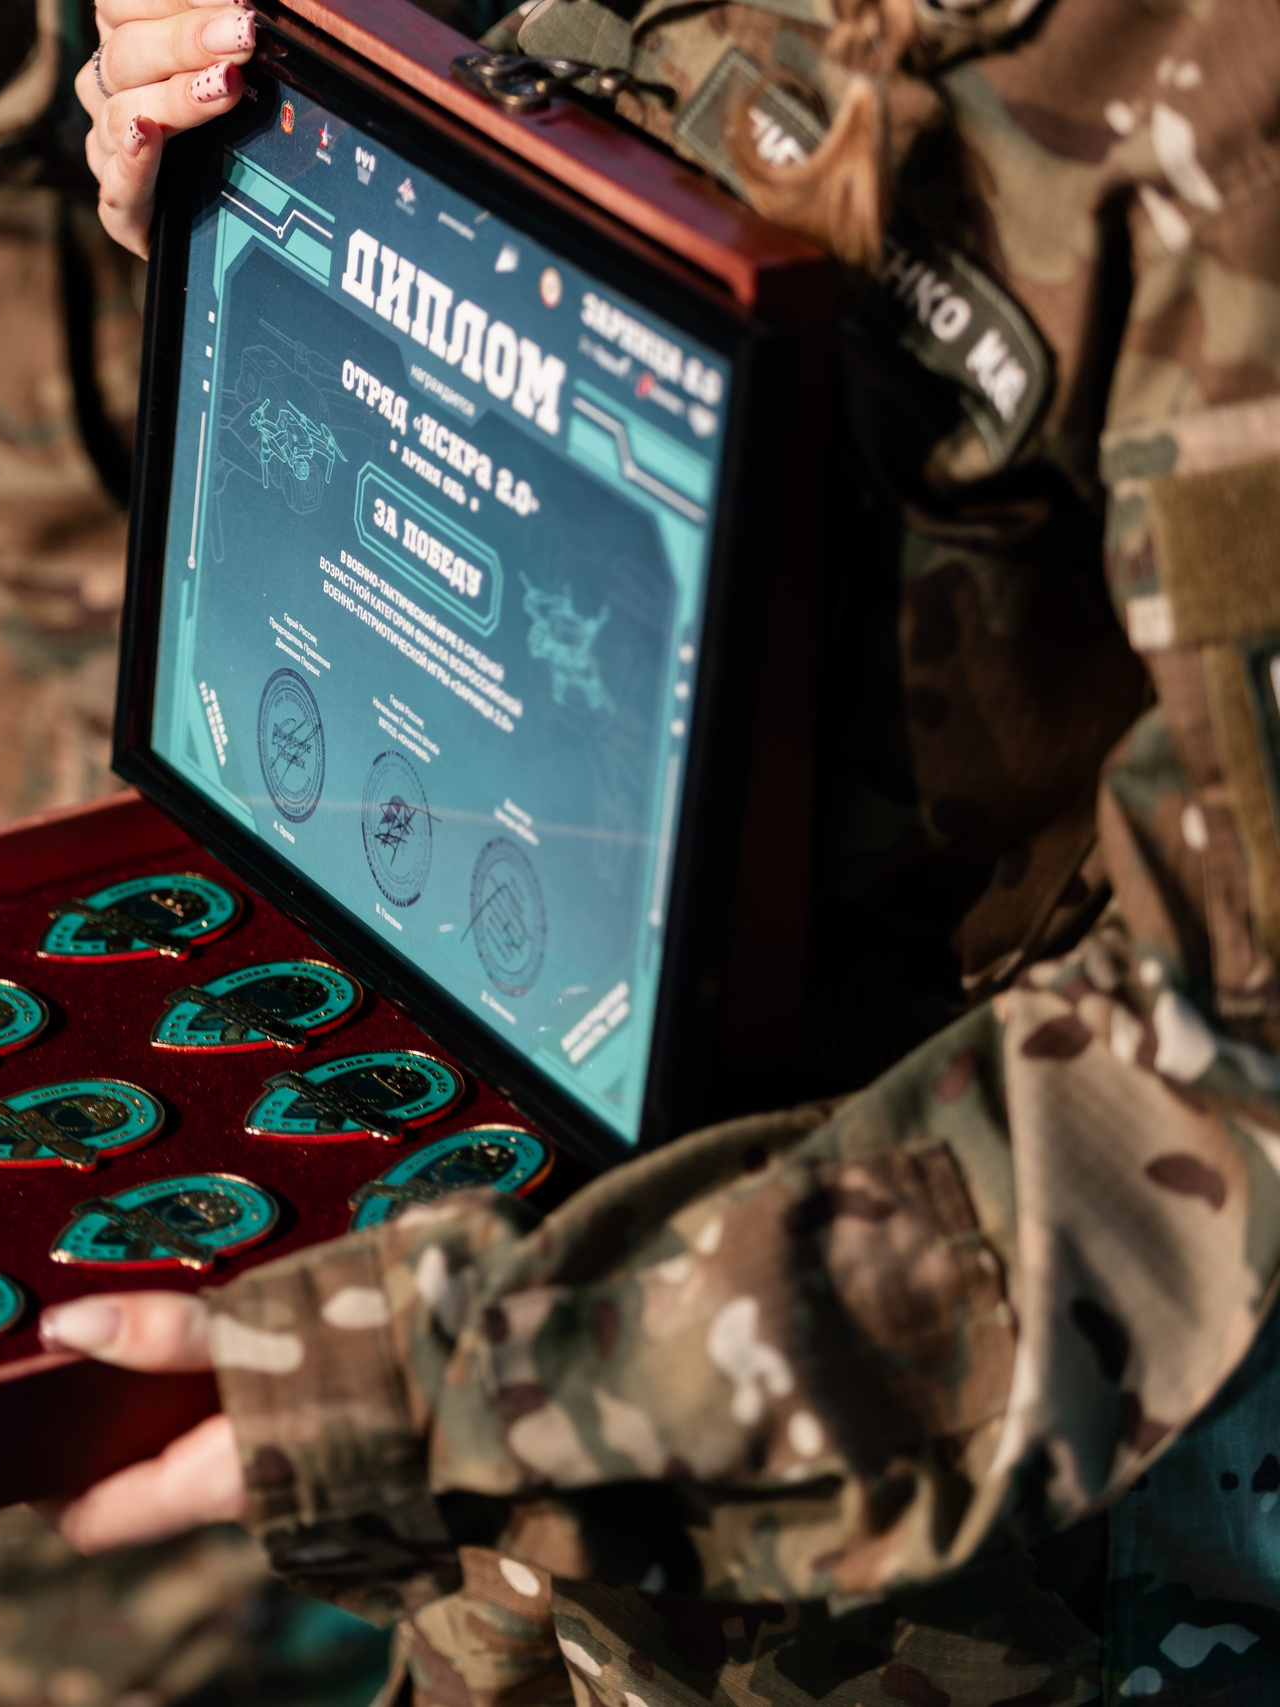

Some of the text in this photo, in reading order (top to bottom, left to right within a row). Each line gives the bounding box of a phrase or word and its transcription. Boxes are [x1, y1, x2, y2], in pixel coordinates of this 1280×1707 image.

[341, 228, 567, 436] ДИПЛОМ
[341, 359, 408, 436] ОТРЯД
[411, 363, 476, 418] награждается
[401, 446, 443, 489] АРМИЯ
[373, 497, 483, 598] ЗА ПОБЕДУ
[269, 616, 331, 670] Председатель Правления
[283, 612, 318, 647] Герой России,
[320, 556, 523, 719] ВОЗРАСТНОЙ КАТЕГОРИИ ФИНАЛА ВСЕРОССИЙСКОЙ
[323, 579, 428, 671] ВОЕННО-ПАТРИОТИЧЕСКОЙ
[427, 662, 451, 687] ИГРЫ
[346, 554, 437, 634] ВОЕННО-ТАКТИЧЕСКОЙ
[435, 620, 459, 646] ИГРЕ
[464, 642, 505, 683] СРЕДНЕЙ
[275, 636, 320, 677] Движения Первых
[271, 721, 312, 755] Движение
[372, 696, 400, 725] Начальник
[399, 717, 423, 743] Главного
[389, 694, 424, 730] Герой России,
[276, 744, 307, 771] Первых
